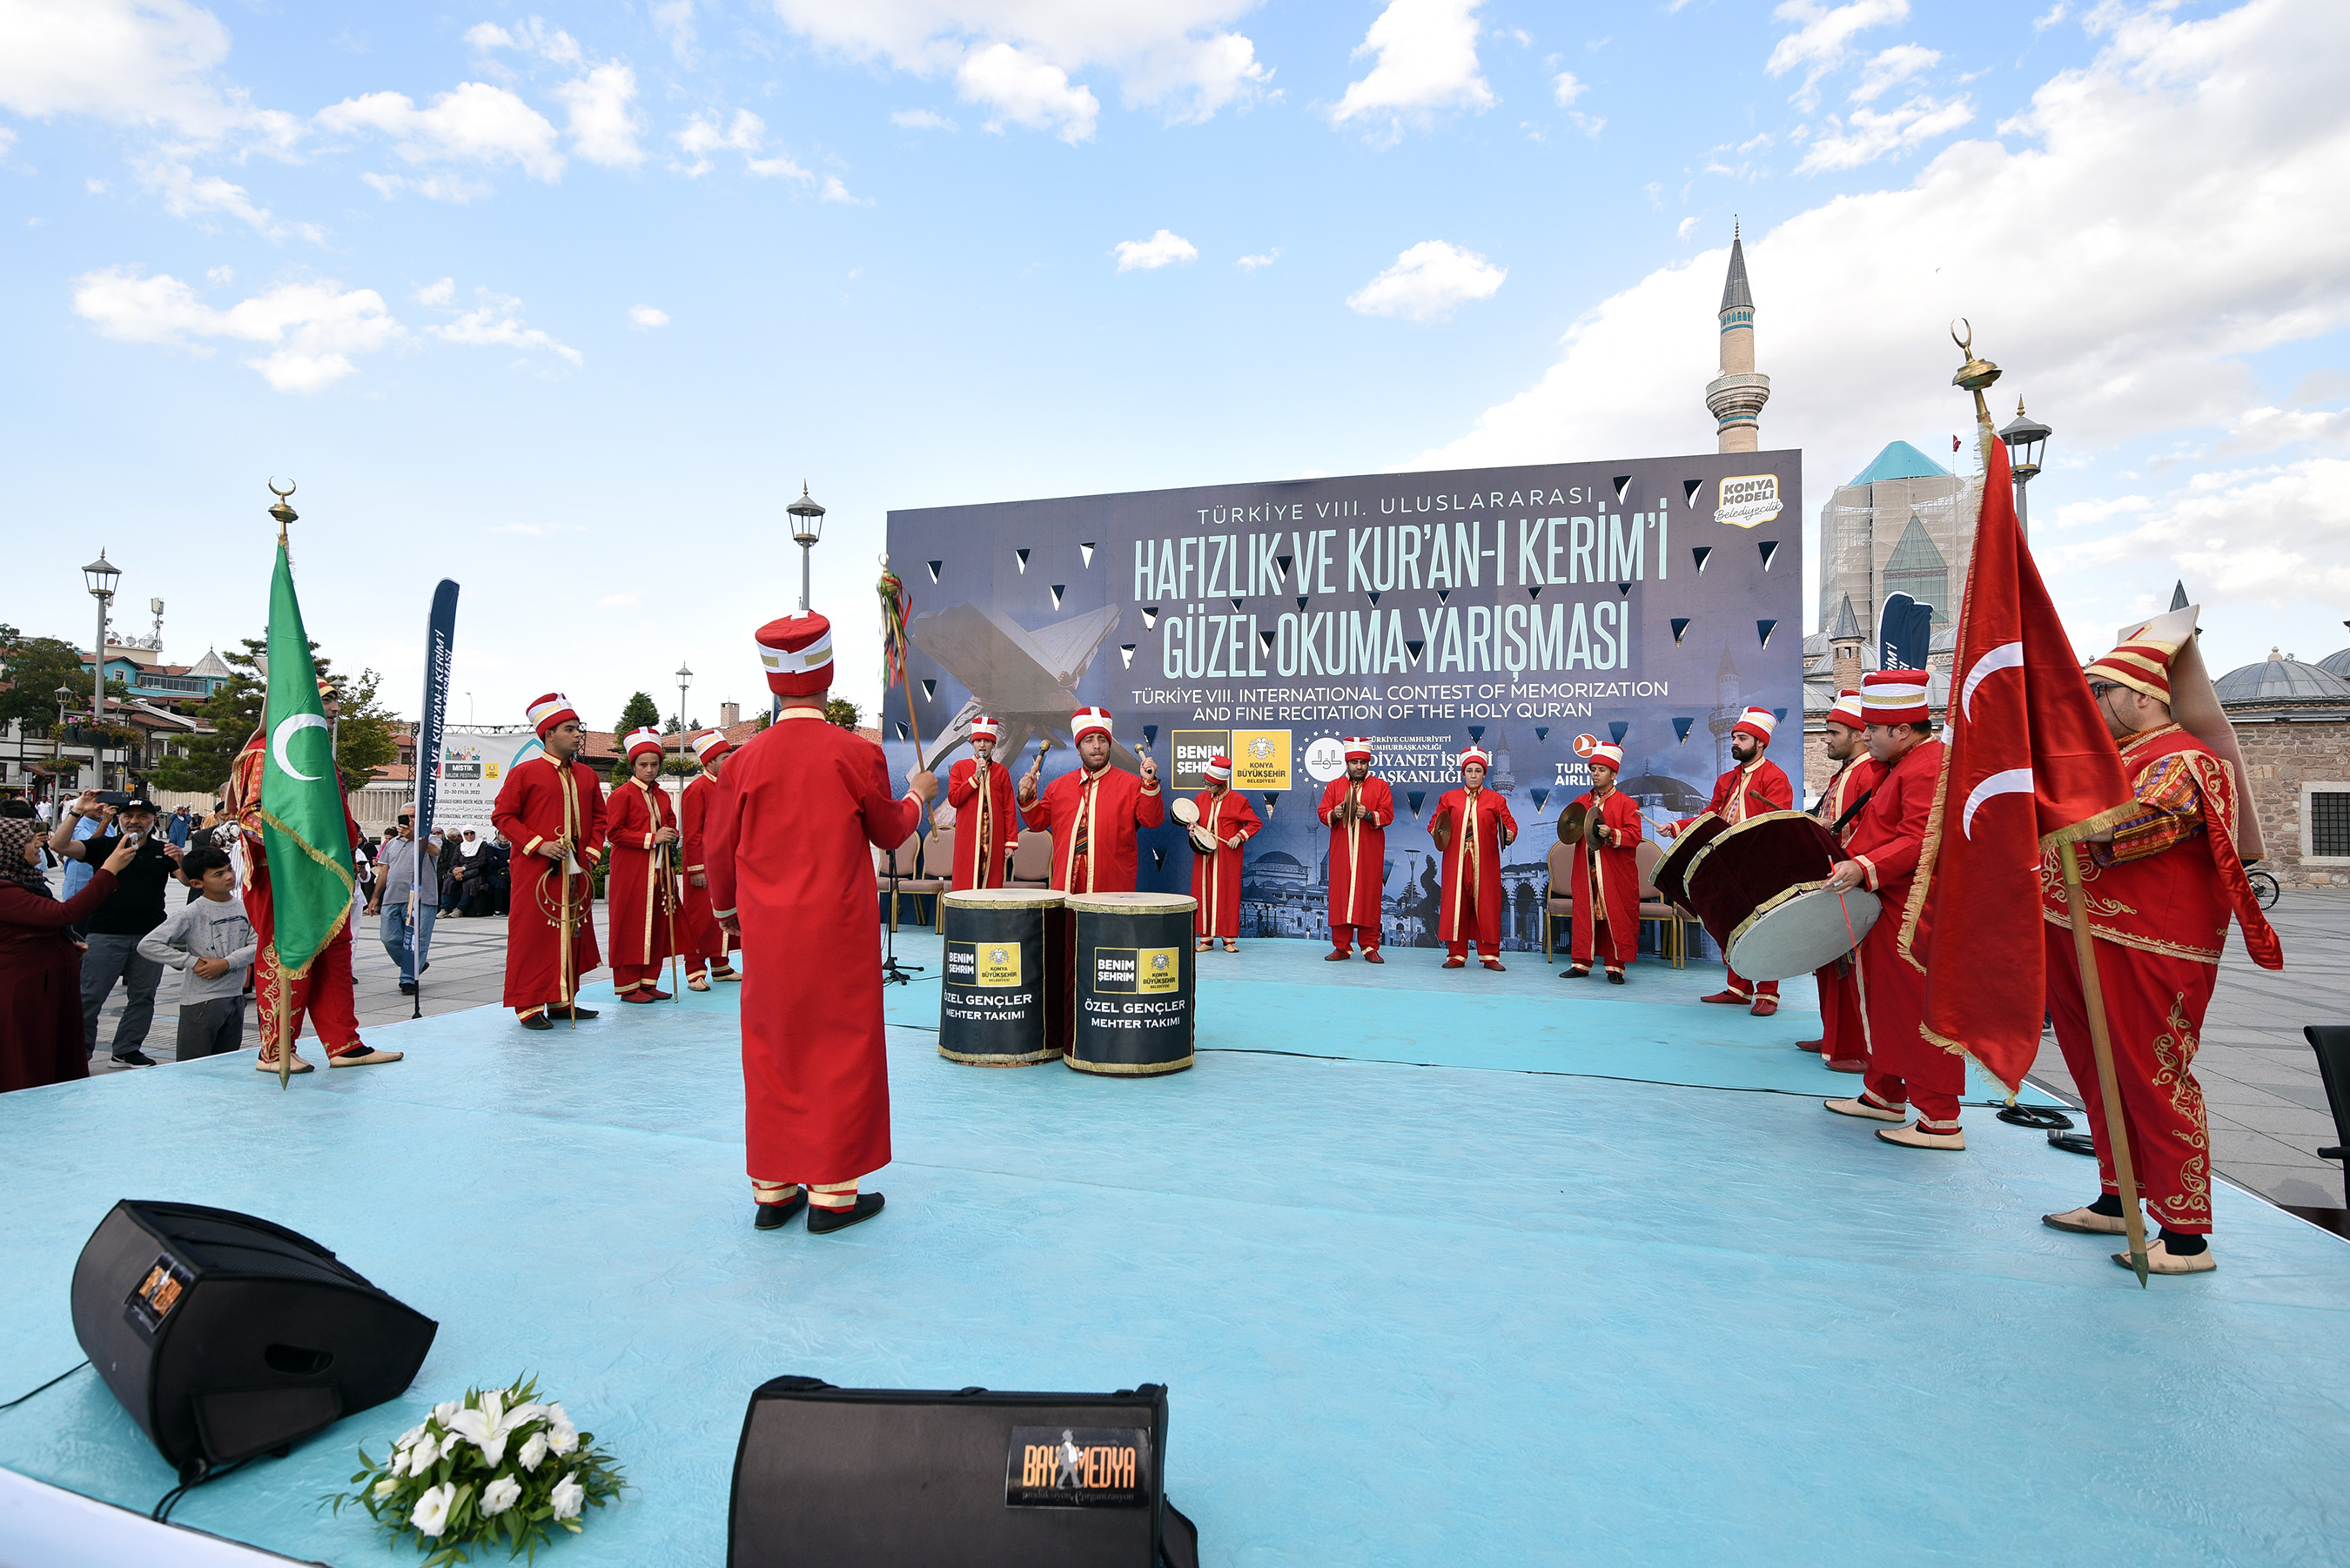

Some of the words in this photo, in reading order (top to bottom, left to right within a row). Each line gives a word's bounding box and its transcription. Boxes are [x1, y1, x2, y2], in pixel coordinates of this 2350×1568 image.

[1724, 479, 1775, 495] KONYA
[1197, 502, 1304, 525] TÜRKİYE
[1316, 499, 1366, 519] VIII.
[1380, 486, 1592, 514] ULUSLARARASI
[1715, 499, 1783, 521] Belediyecilik
[1134, 532, 1283, 601] HAFIZLIK
[1292, 529, 1337, 595] VE
[1347, 519, 1506, 593] KUR'AN-I
[1519, 497, 1668, 586] KERİM'İ
[1163, 603, 1267, 680] GÜZEL
[1277, 609, 1407, 677] OKUMA
[1418, 600, 1628, 683] YARIŞMASI
[1131, 687, 1202, 705] TÜRKİYE
[1206, 689, 1234, 704] VIII.
[1239, 686, 1383, 703] INTERNATIONAL
[1386, 684, 1474, 701] CONTEST
[1479, 683, 1506, 700] OF
[1511, 680, 1668, 699] MEMORIZATION
[1192, 707, 1232, 722] AND
[1235, 706, 1274, 721] FINE
[1279, 705, 1383, 720] RECITATION
[1387, 703, 1414, 720] OF
[1417, 703, 1455, 720] THE
[1460, 702, 1513, 719] HOLY
[1516, 701, 1593, 719] QUR'AN
[1371, 743, 1442, 752] UMHURBAŞKANLIĞI
[1177, 761, 1209, 775] ŞEHR
[1368, 751, 1438, 767] DİYANET
[1237, 768, 1286, 778] BÜYÜKŞEHİR
[943, 988, 964, 1004] ÖZEL
[965, 994, 1032, 1008] GENÇLER
[1084, 998, 1119, 1014] ÖZEL
[1122, 1000, 1185, 1015] GENÇLER
[945, 1008, 982, 1020] MEHTER
[984, 1010, 1025, 1021] TAKIMI
[1091, 1017, 1141, 1029] MEHTER
[1144, 1016, 1180, 1028] TAKIMI
[1023, 1444, 1061, 1487] BAY
[1071, 1446, 1137, 1489] MEDYA
